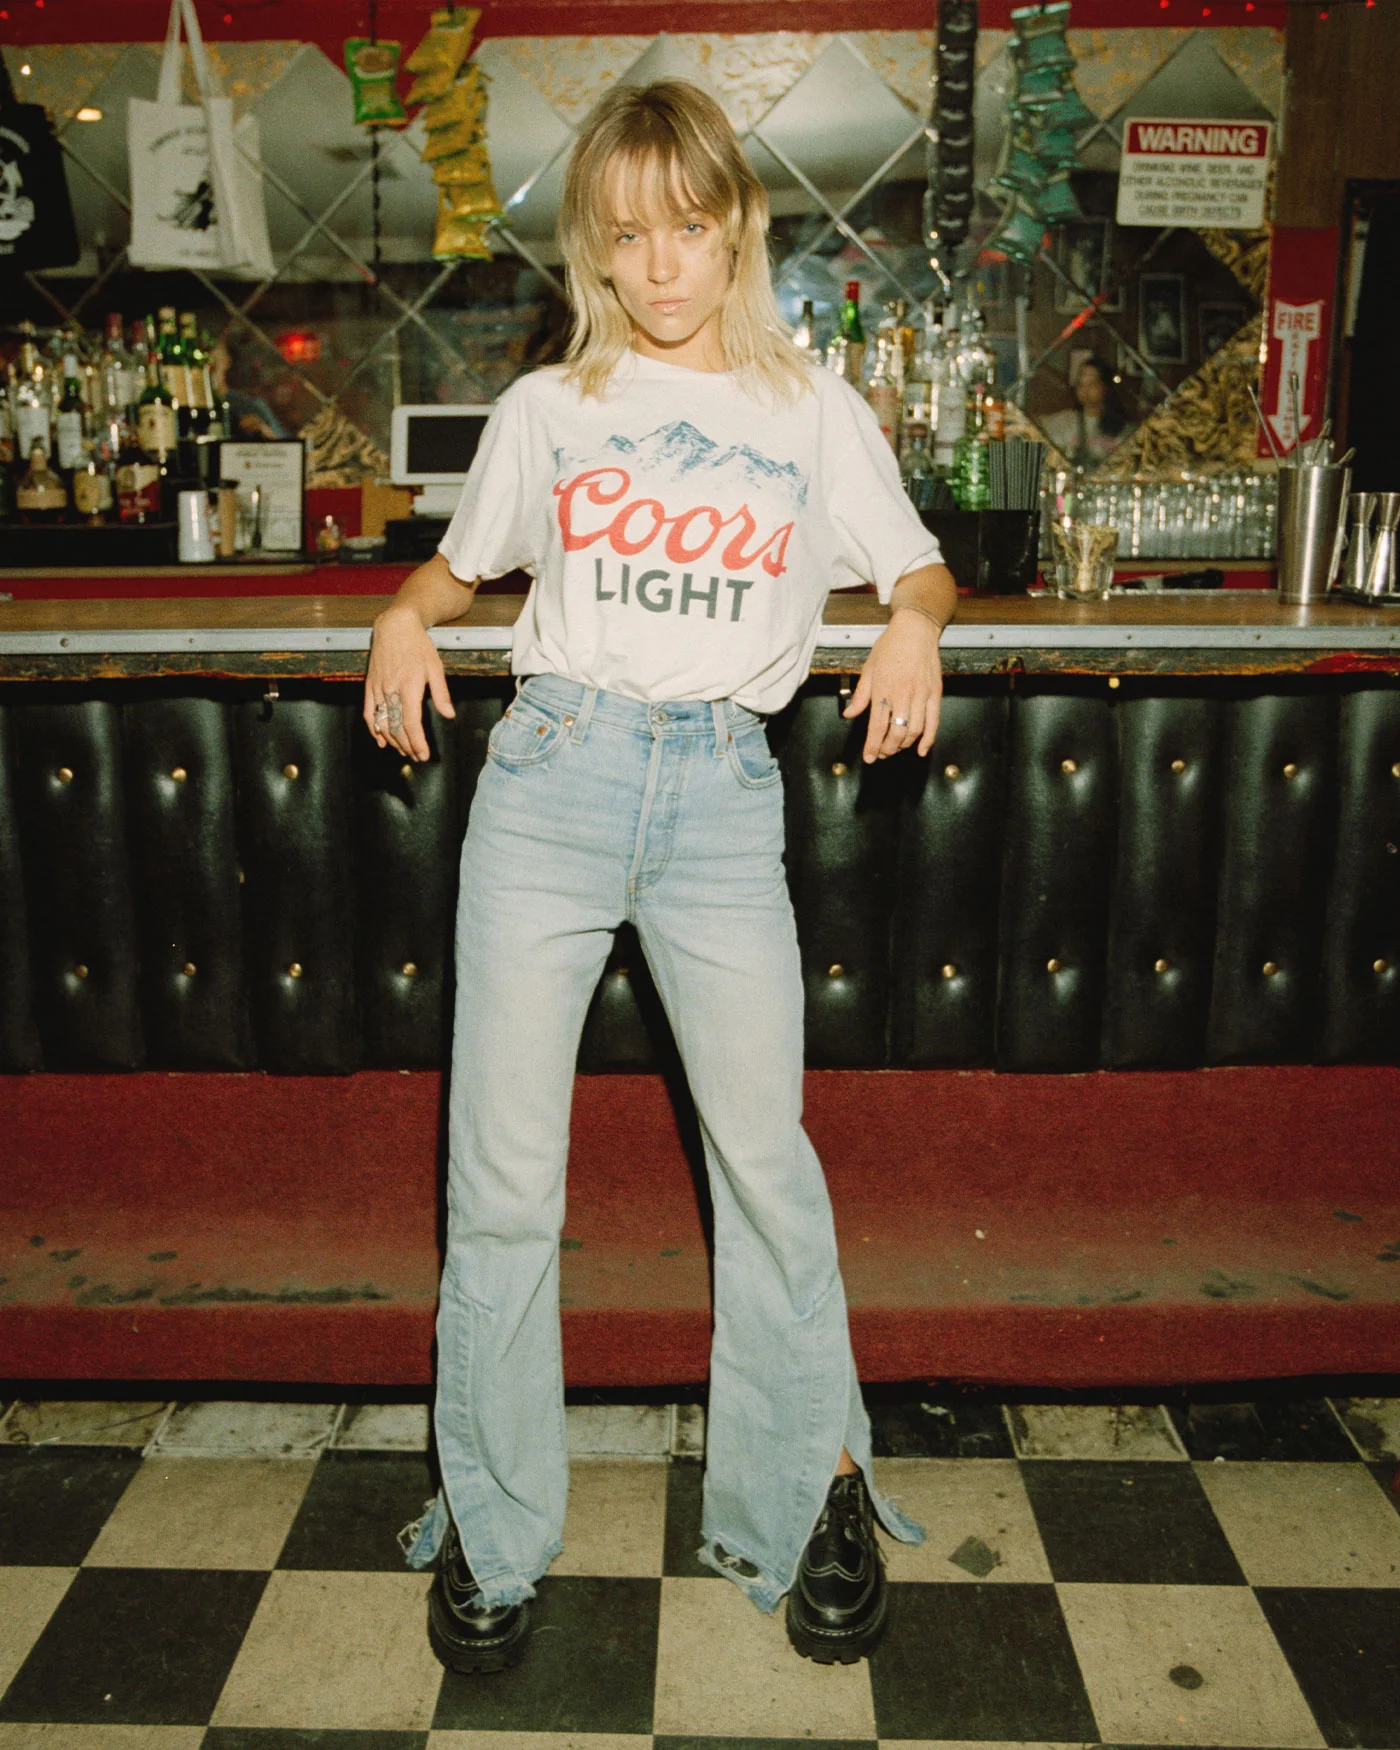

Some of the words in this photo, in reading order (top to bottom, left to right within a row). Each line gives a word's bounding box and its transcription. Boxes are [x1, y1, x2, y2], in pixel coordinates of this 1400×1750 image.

[1137, 125, 1259, 154] WARNING
[1277, 311, 1316, 332] FIRE
[552, 467, 795, 578] Coors
[595, 557, 755, 622] LIGHT
